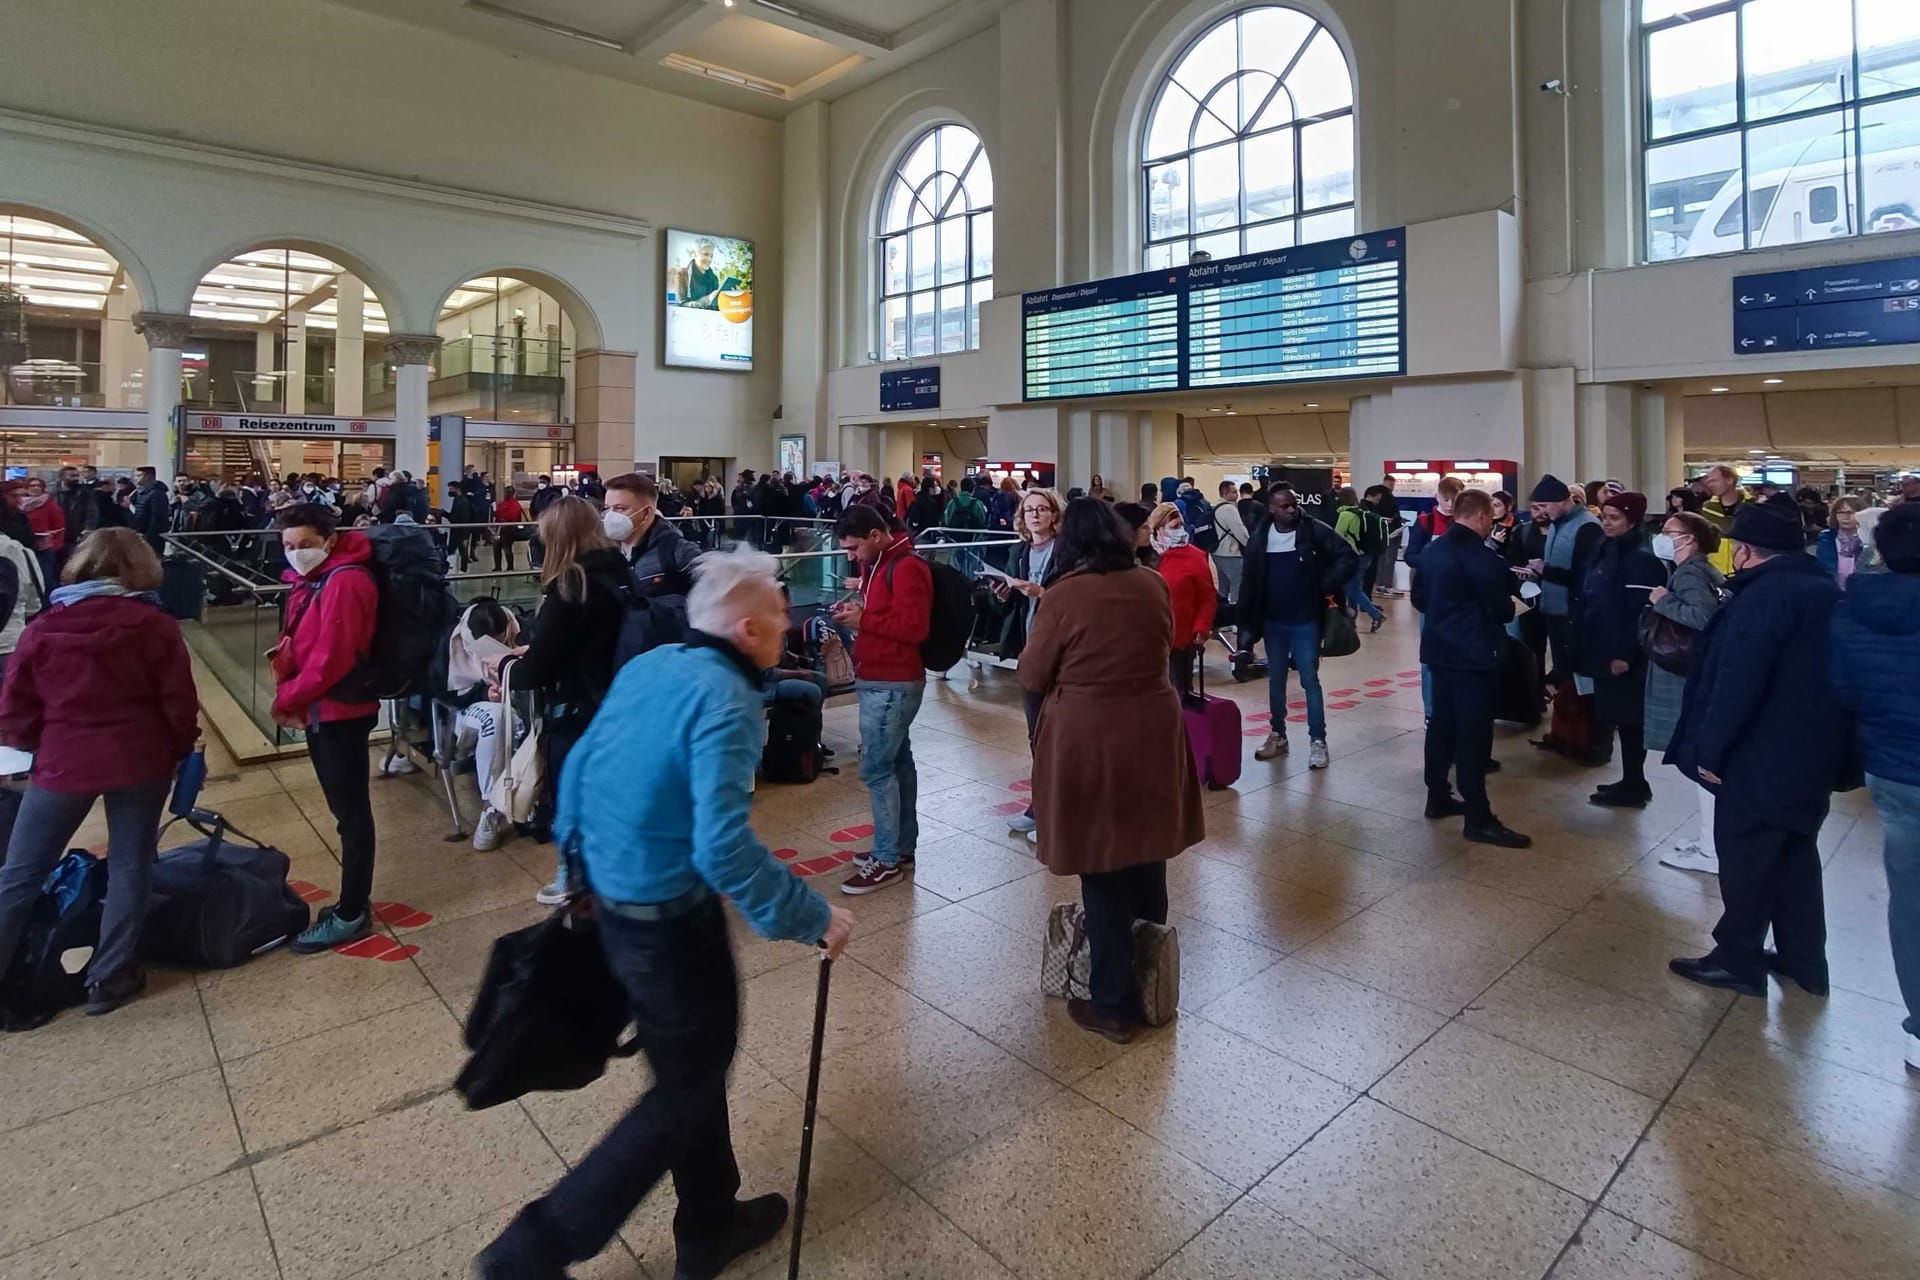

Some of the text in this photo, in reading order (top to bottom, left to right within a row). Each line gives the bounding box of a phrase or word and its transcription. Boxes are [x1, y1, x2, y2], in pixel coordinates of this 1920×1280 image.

[1188, 265, 1218, 278] Abfahrt
[1224, 260, 1256, 272] Departure
[1263, 255, 1287, 266] Départ
[1026, 294, 1048, 304] Abfahrt
[1051, 291, 1076, 301] Departure
[239, 419, 335, 432] Reisezentrum
[1253, 467, 1260, 477] 2
